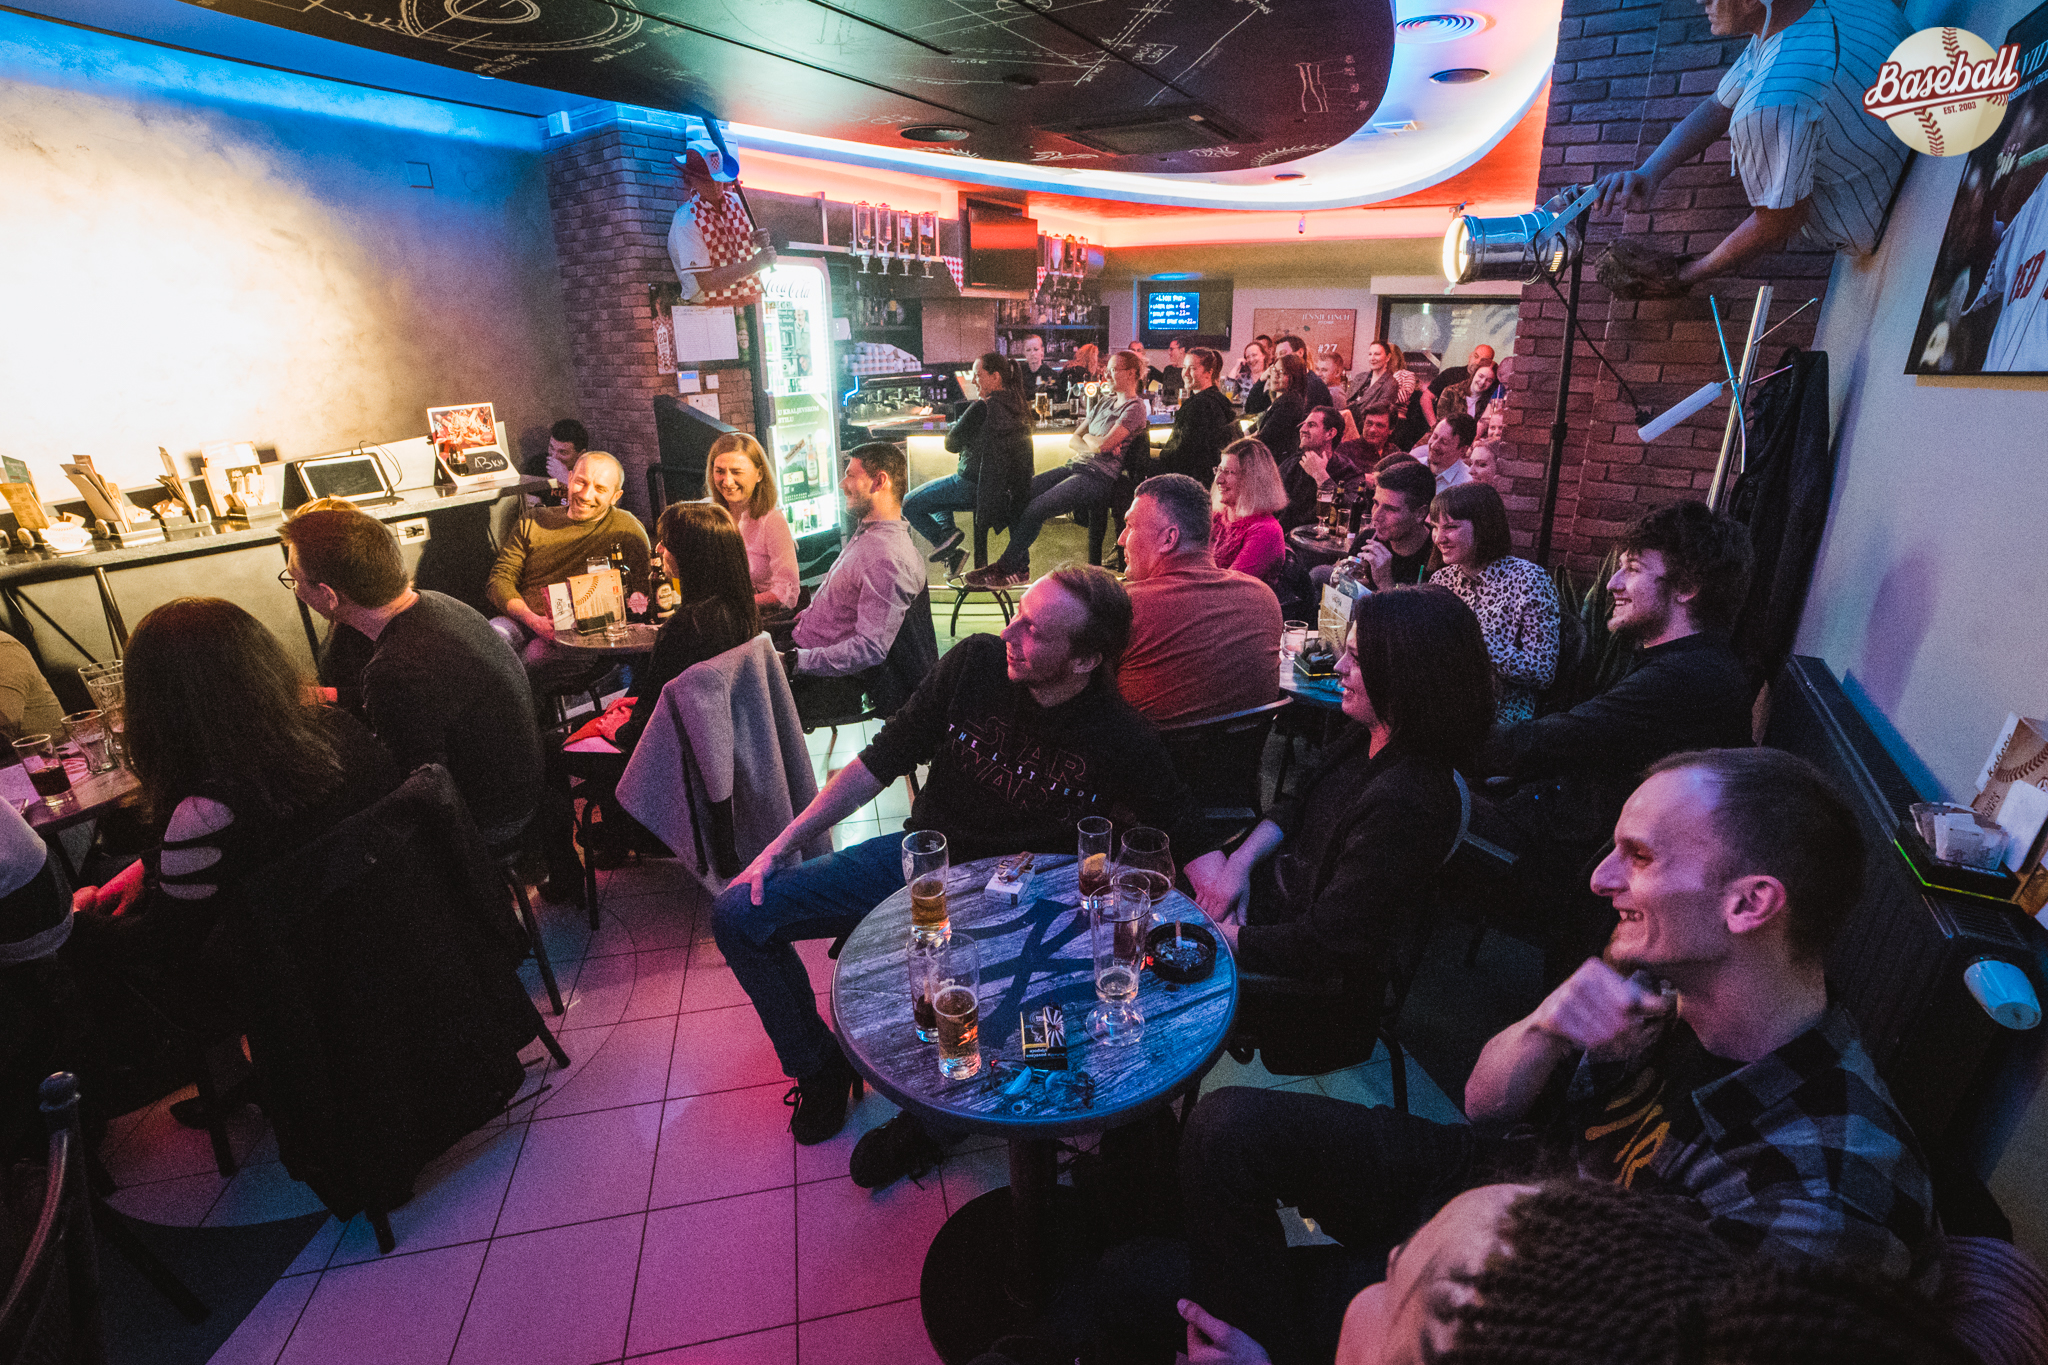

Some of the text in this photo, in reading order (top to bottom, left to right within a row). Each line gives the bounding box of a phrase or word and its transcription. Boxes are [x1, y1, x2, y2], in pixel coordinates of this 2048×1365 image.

[2007, 249, 2046, 306] RED
[1317, 343, 1338, 353] #27
[948, 723, 978, 749] THE
[1049, 782, 1097, 803] JEDI
